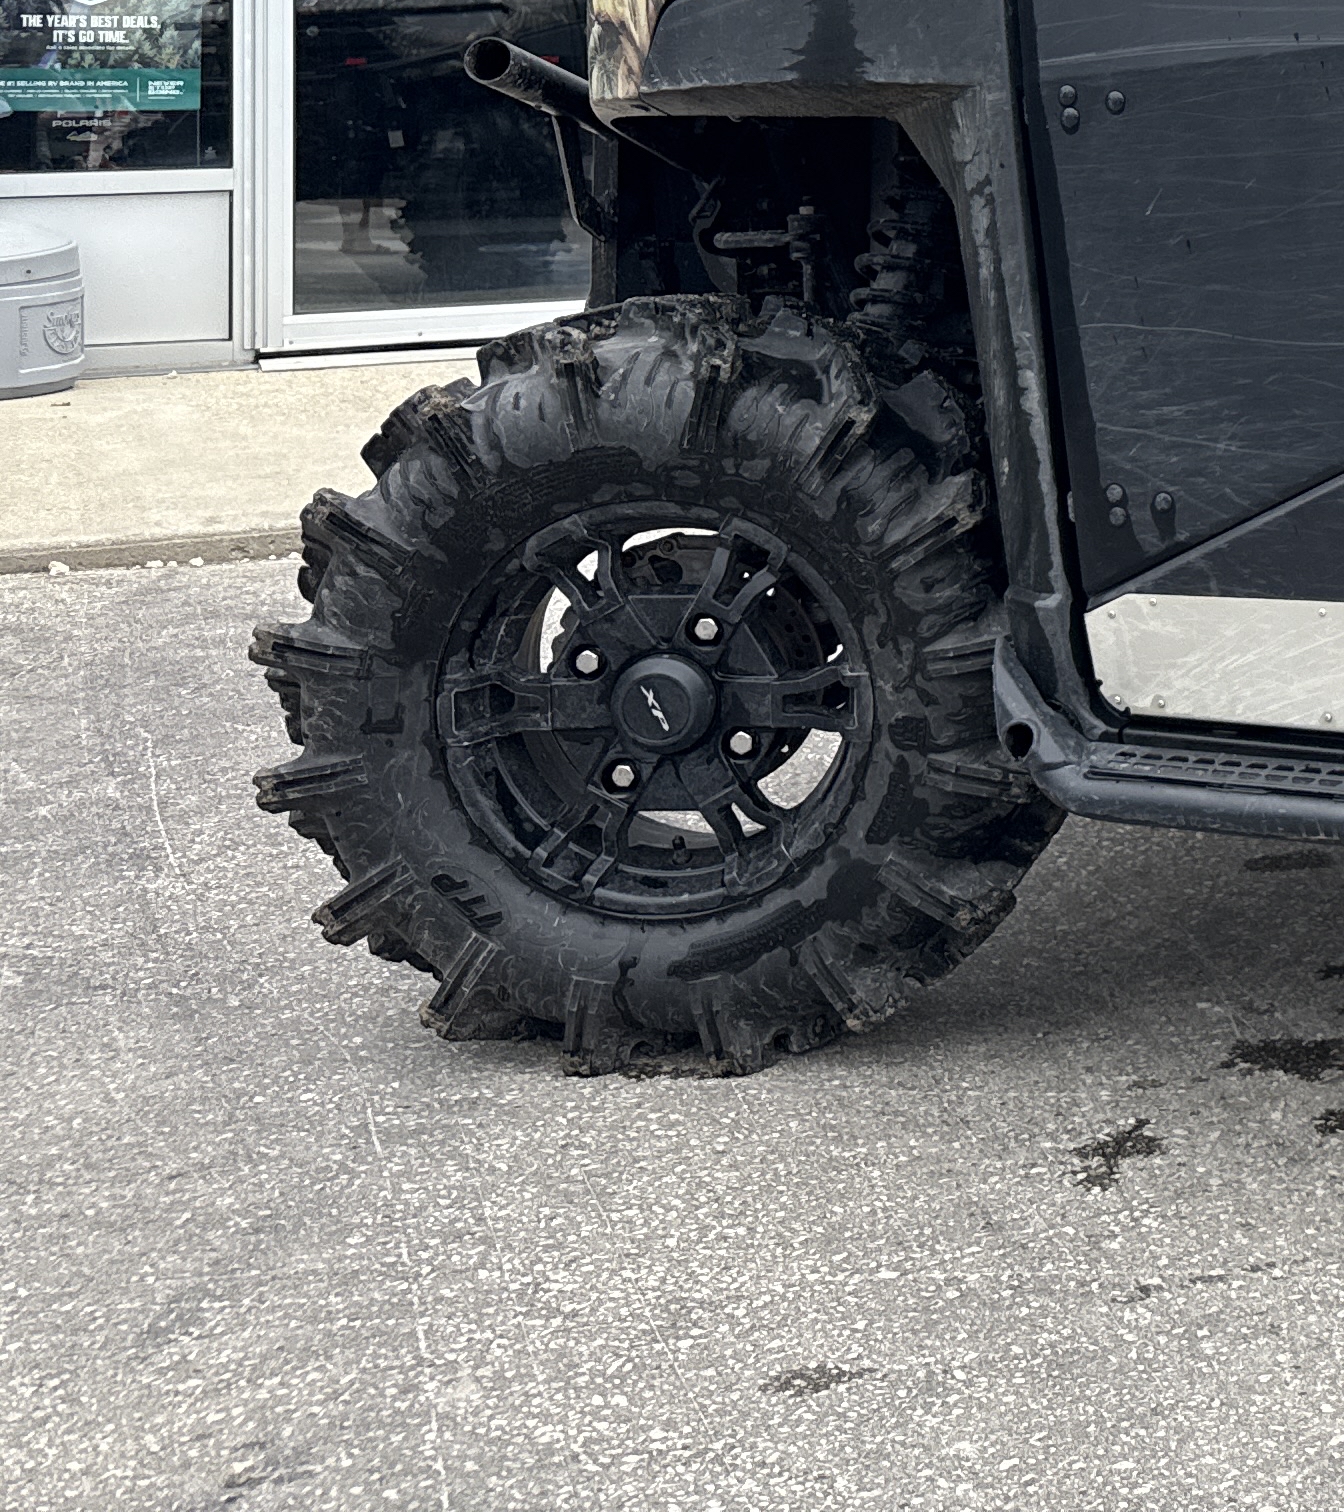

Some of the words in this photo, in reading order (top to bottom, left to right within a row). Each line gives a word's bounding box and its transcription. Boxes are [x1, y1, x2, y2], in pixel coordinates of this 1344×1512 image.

[20, 14, 43, 27] THE
[46, 14, 87, 28] YEAR'S
[90, 15, 119, 28] BEST
[122, 16, 161, 28] DEALS.
[52, 30, 75, 43] IT'S
[78, 31, 95, 43] GO
[52, 119, 112, 128] POLARIS
